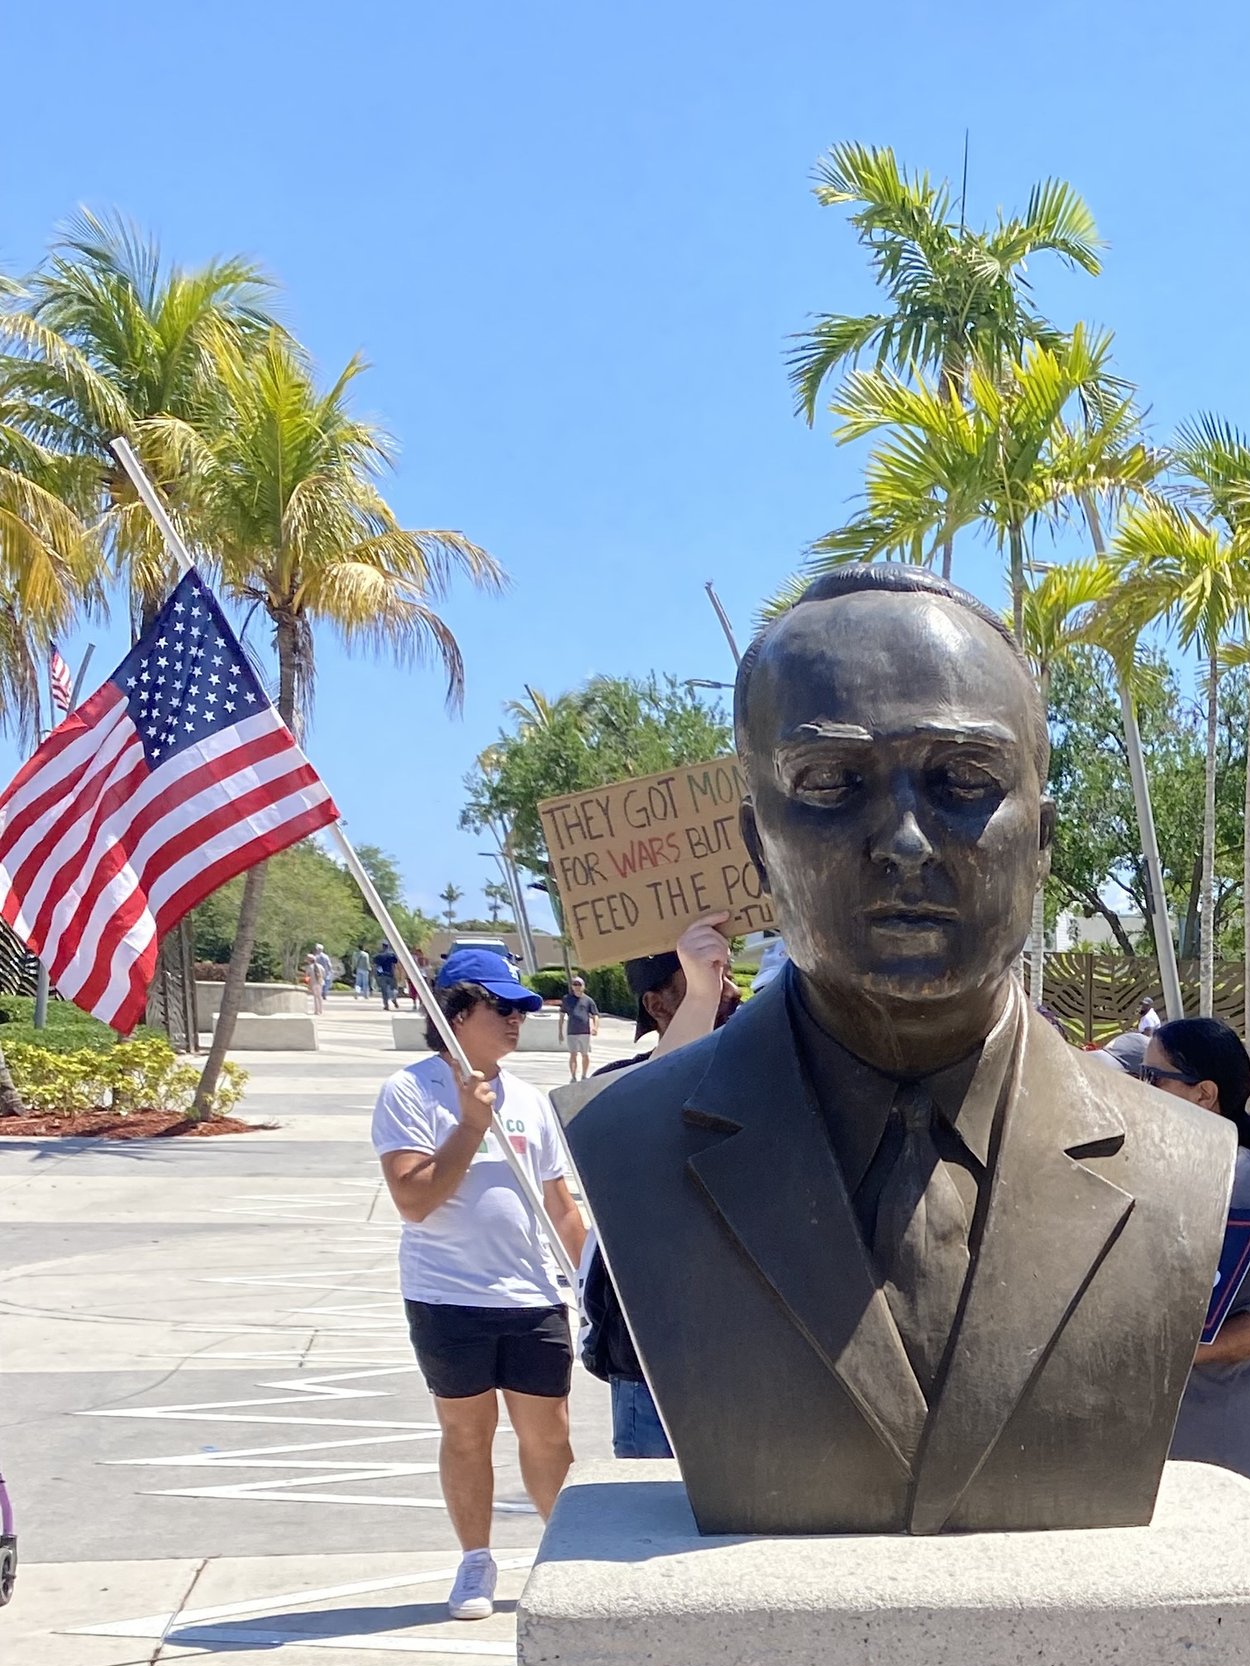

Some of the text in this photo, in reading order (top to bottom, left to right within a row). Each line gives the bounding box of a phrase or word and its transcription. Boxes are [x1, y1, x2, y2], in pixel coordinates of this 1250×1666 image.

[542, 796, 615, 849] THEY
[623, 777, 678, 829] GOT
[560, 815, 735, 891] FOR WARS BUT
[572, 891, 639, 940] FEED
[646, 872, 711, 920] THE
